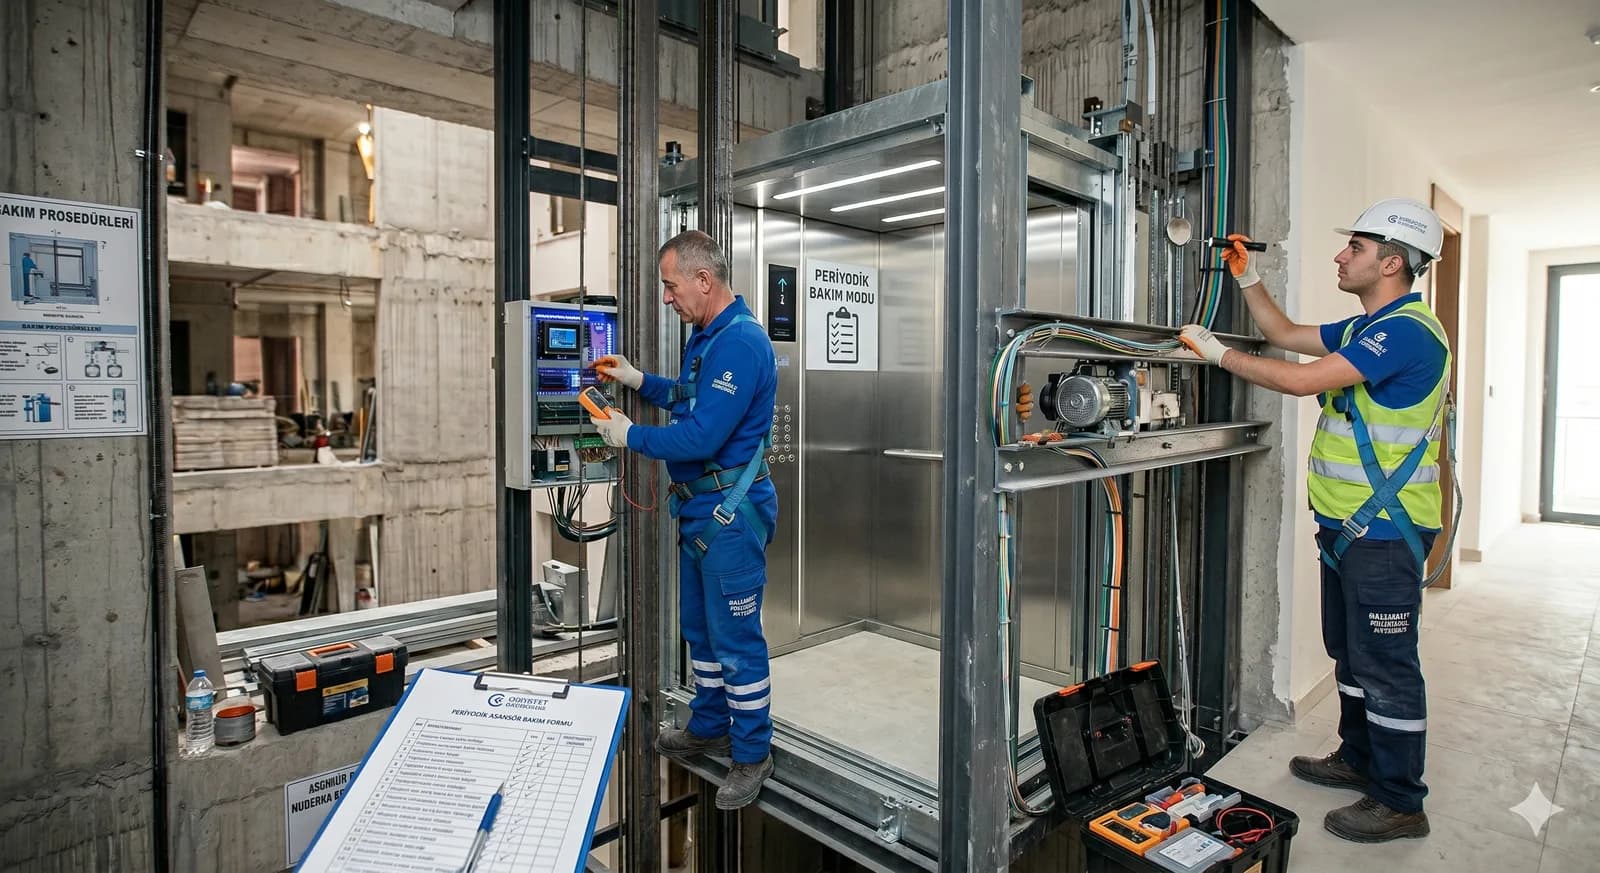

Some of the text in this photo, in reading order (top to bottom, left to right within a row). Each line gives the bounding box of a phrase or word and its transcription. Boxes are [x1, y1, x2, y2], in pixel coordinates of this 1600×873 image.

[0, 204, 134, 229] AKIM PROSEDÜRLERİ
[815, 268, 869, 287] PERİYODİK
[809, 287, 875, 304] BAKIM MODU
[488, 713, 522, 722] ASANSÖR
[522, 716, 546, 724] BAKIM
[546, 719, 573, 727] FORMU
[291, 793, 332, 814] NUDERKA
